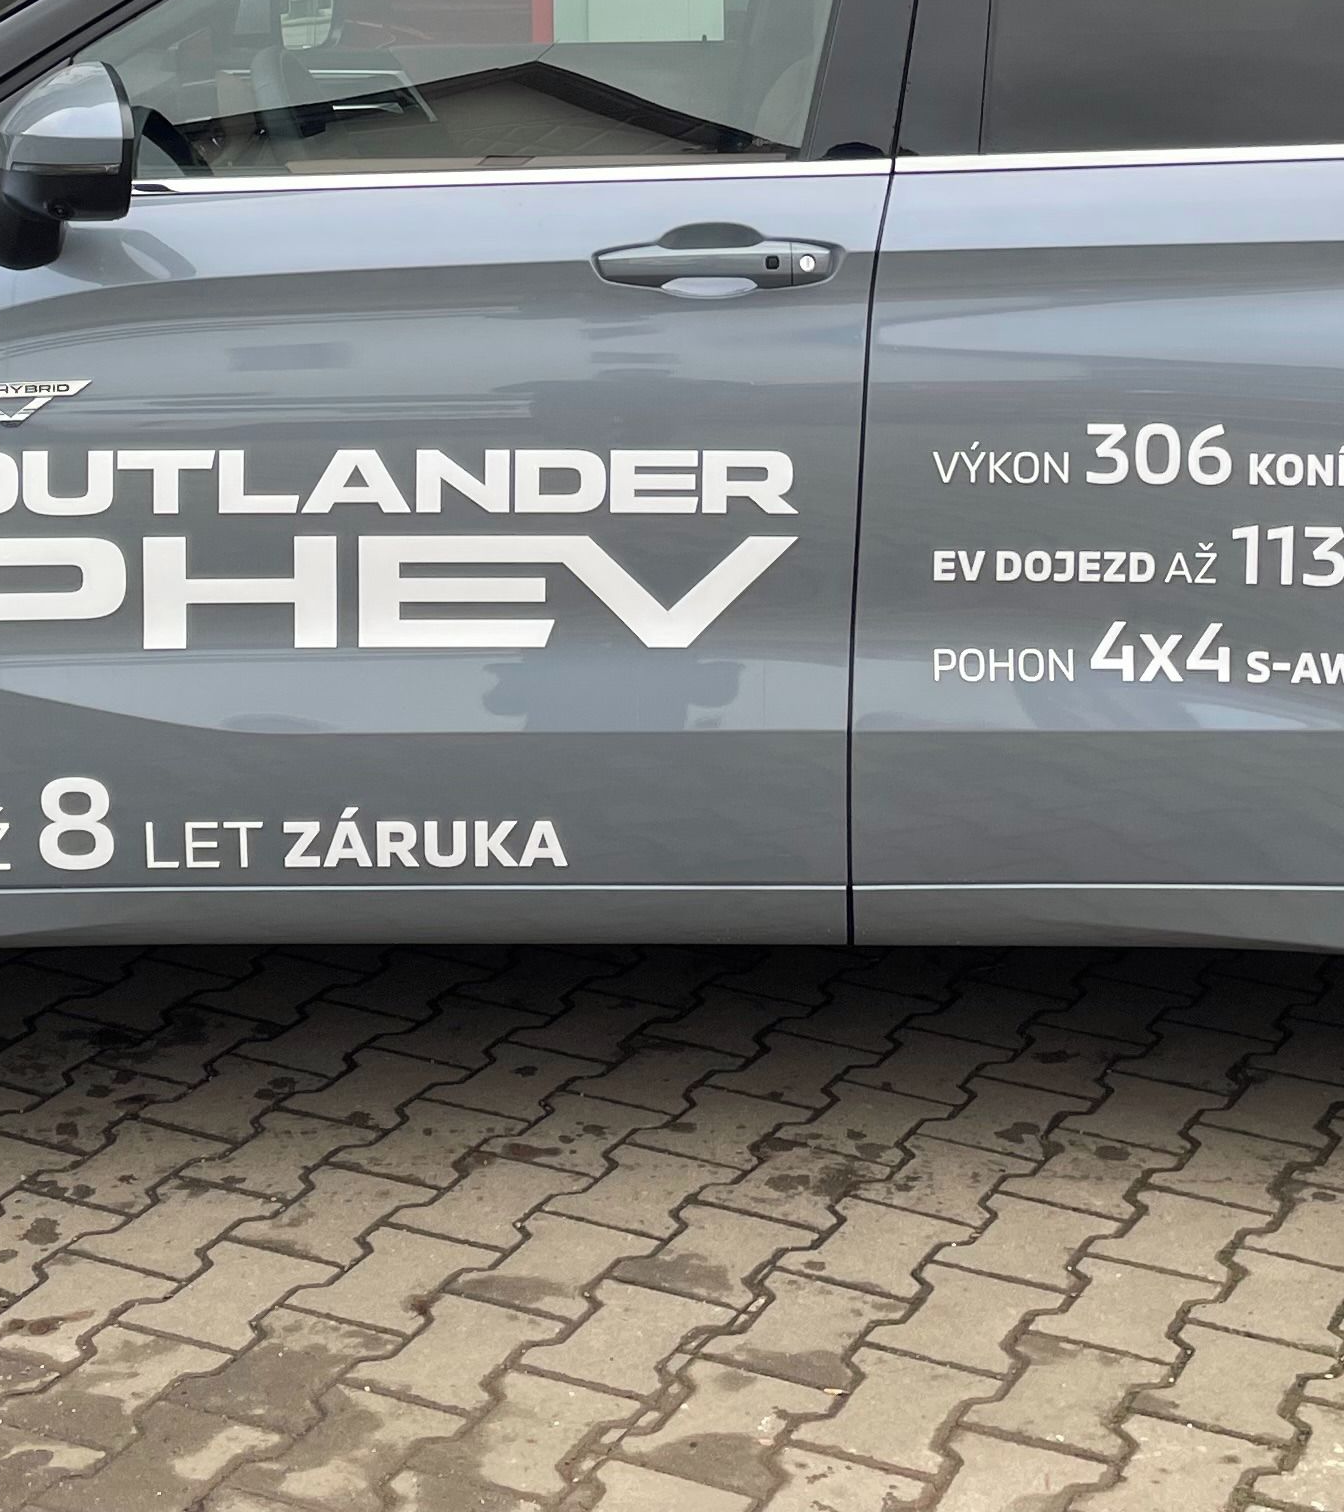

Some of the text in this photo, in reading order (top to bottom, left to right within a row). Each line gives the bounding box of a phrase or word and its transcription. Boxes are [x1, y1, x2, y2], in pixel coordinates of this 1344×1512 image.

[932, 441, 1070, 485] VÝKON
[1085, 422, 1232, 487] 306
[933, 550, 985, 582] EV
[995, 550, 1156, 583] DOJEZD
[1164, 542, 1218, 585] AŽ
[933, 648, 1074, 682] POHON
[37, 776, 115, 871] 8
[145, 820, 264, 870] LET
[282, 806, 569, 868] ZÁRUKA
